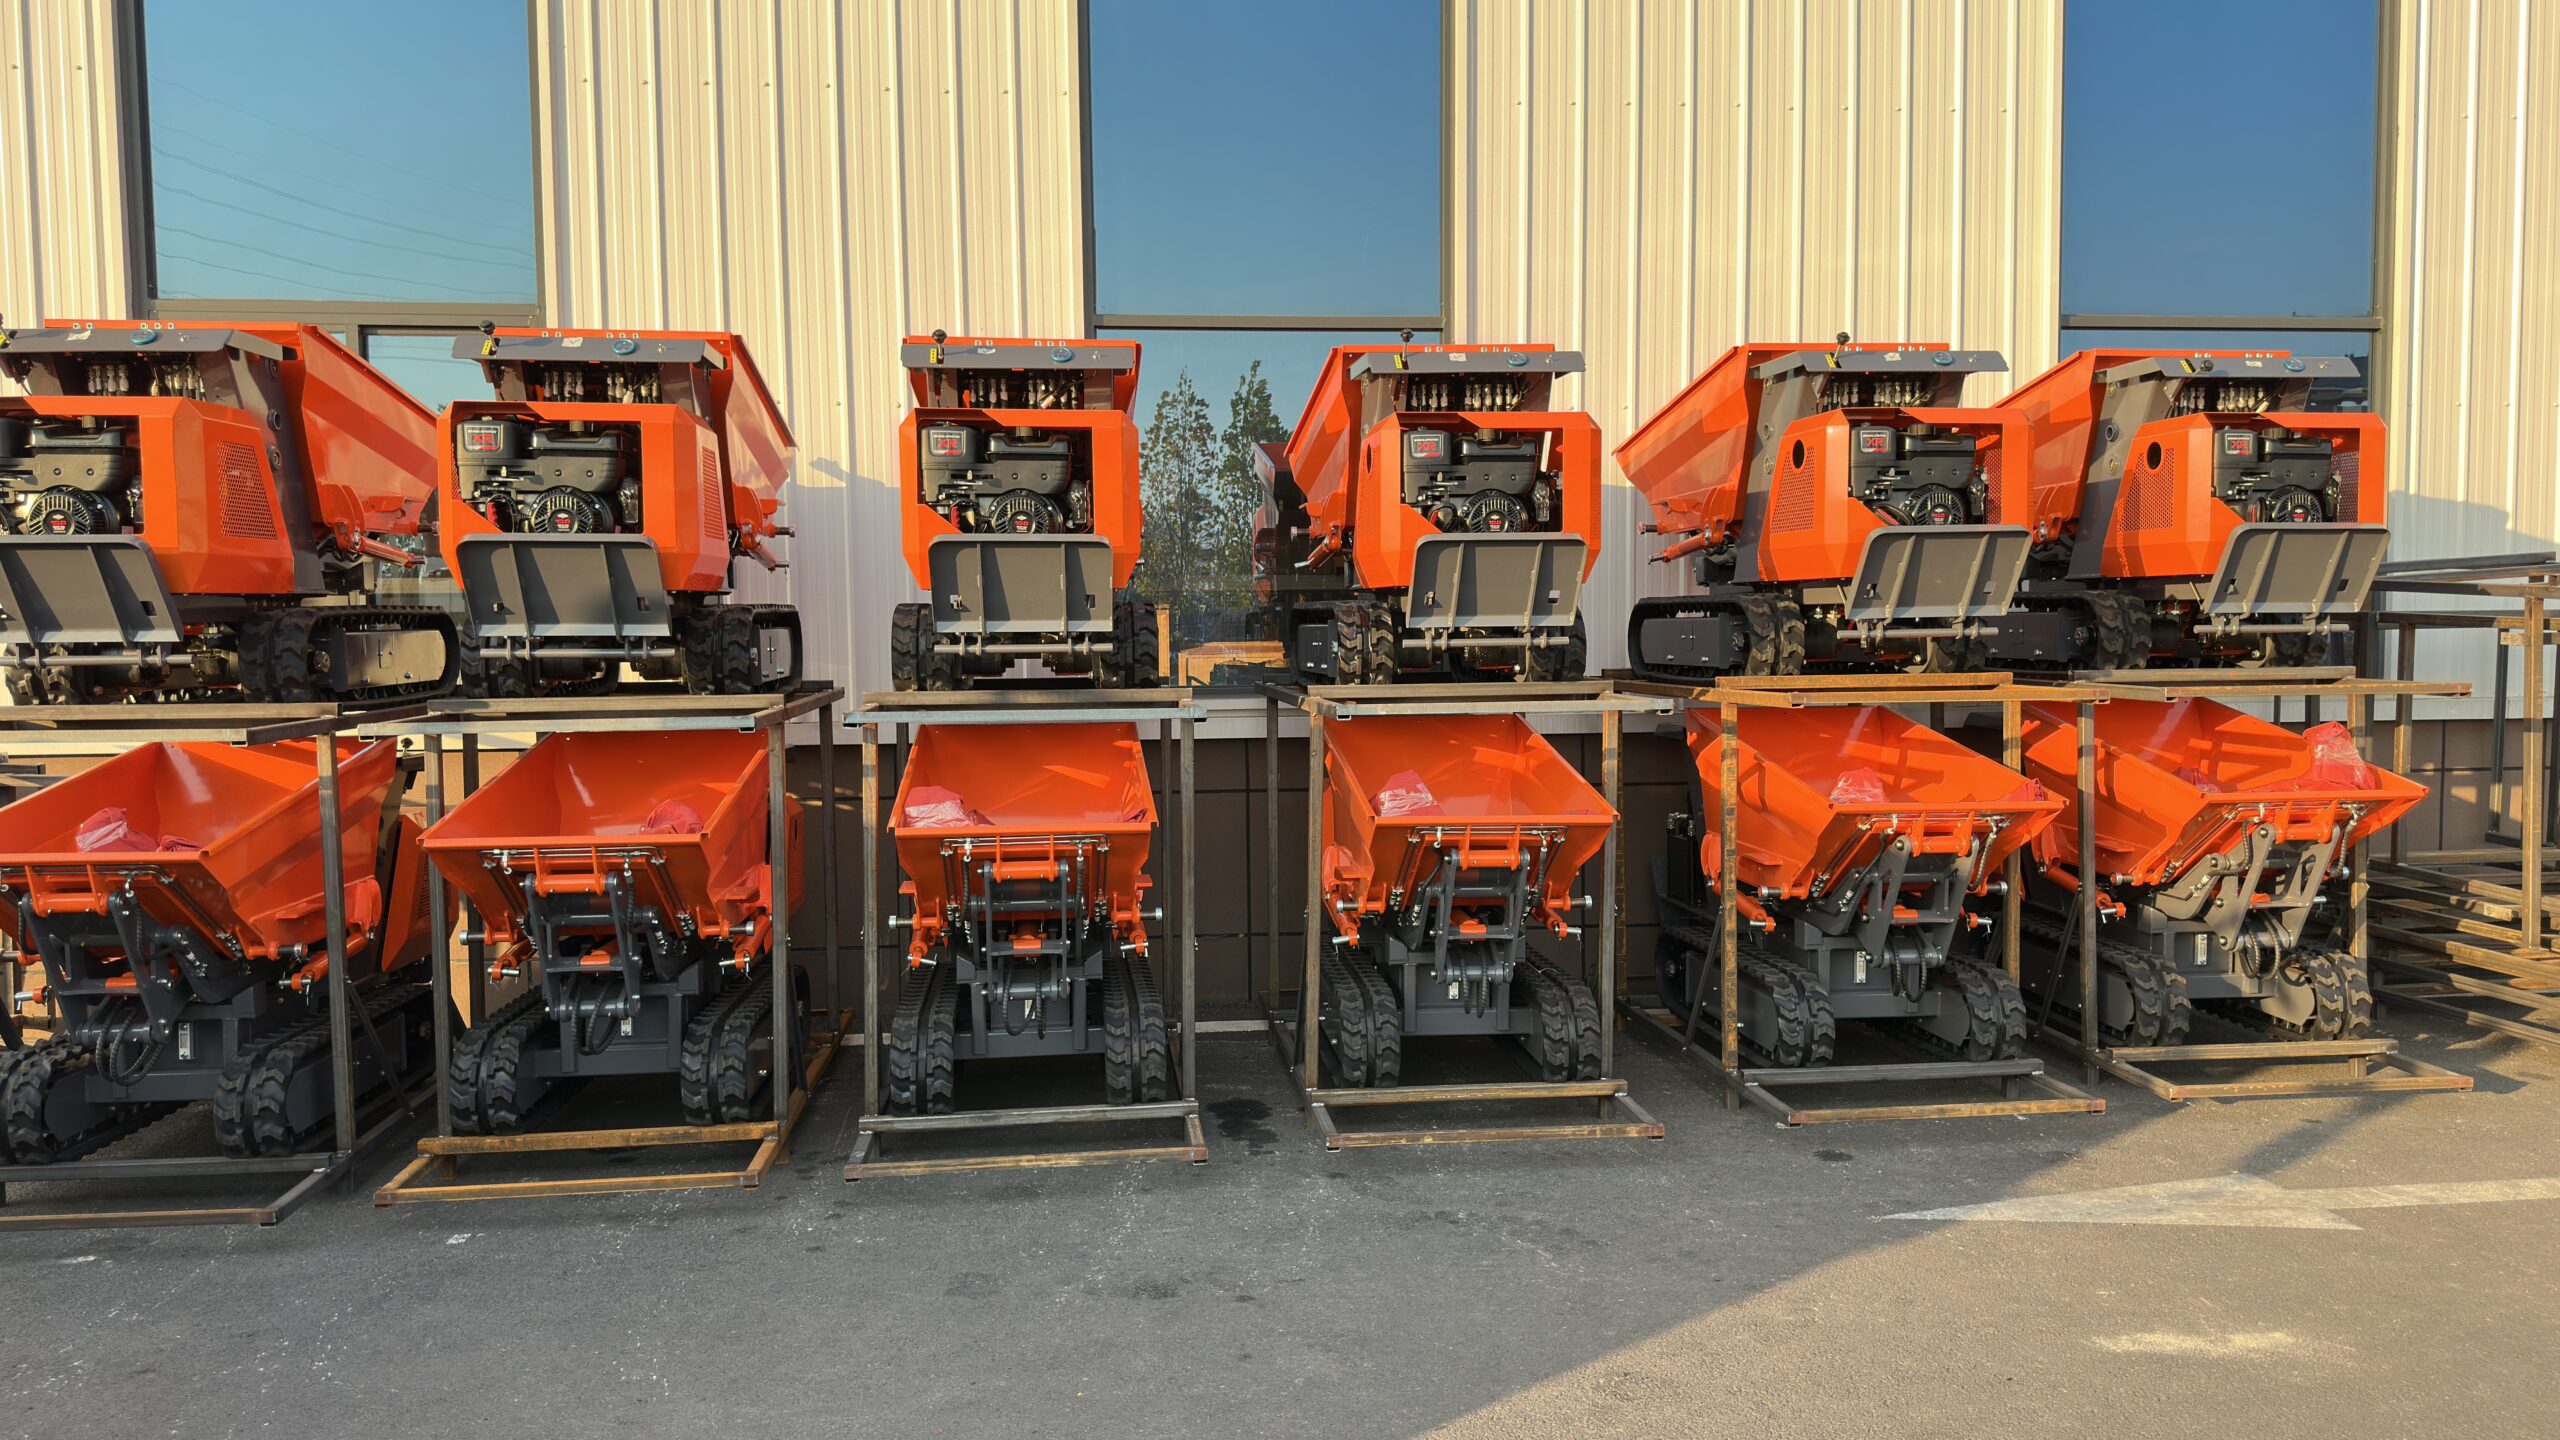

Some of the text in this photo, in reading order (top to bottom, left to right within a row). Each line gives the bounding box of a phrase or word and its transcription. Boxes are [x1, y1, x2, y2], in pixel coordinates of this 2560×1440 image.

[472, 434, 493, 443] XR
[937, 438, 957, 448] XR
[1866, 437, 1885, 447] XR
[1416, 441, 1437, 451] XR
[2230, 440, 2249, 449] XR
